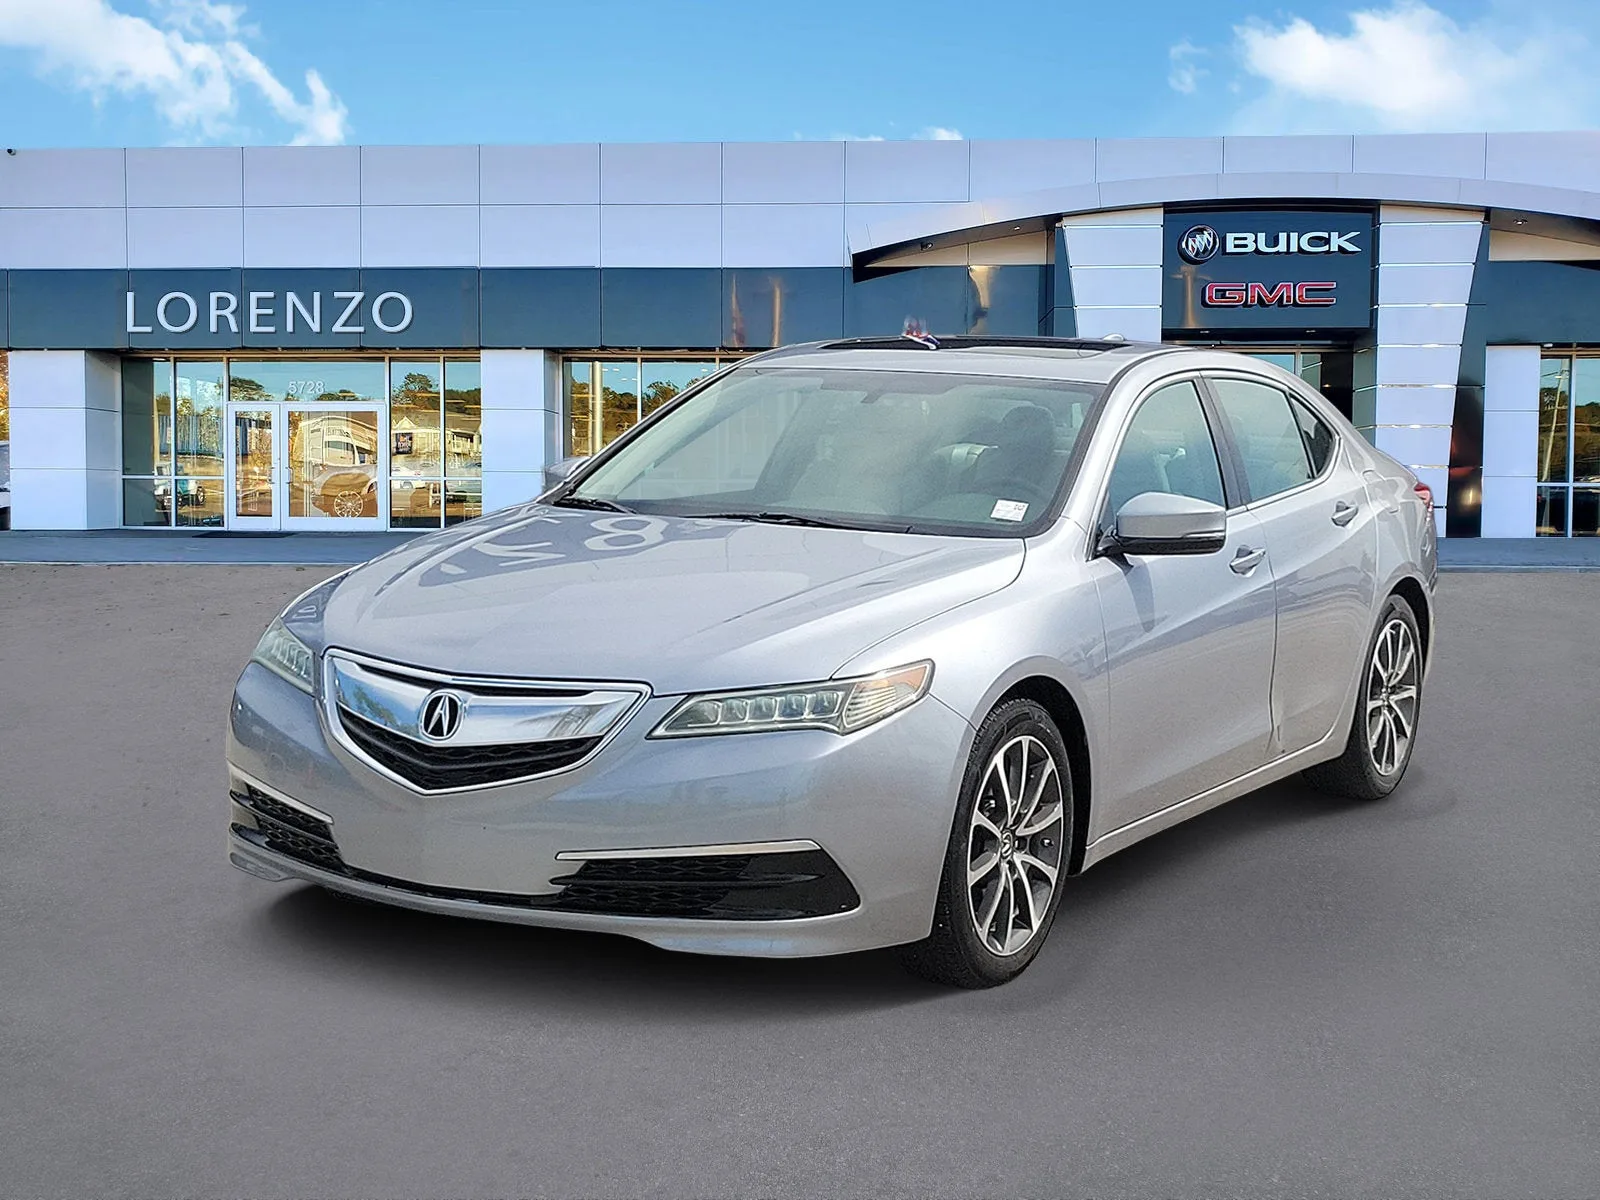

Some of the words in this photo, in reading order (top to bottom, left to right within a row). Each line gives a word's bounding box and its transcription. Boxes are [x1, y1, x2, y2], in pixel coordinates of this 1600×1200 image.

[1225, 231, 1362, 253] BUICK
[1205, 282, 1337, 305] GMC
[126, 291, 413, 333] LORENZO
[288, 380, 325, 394] 5728
